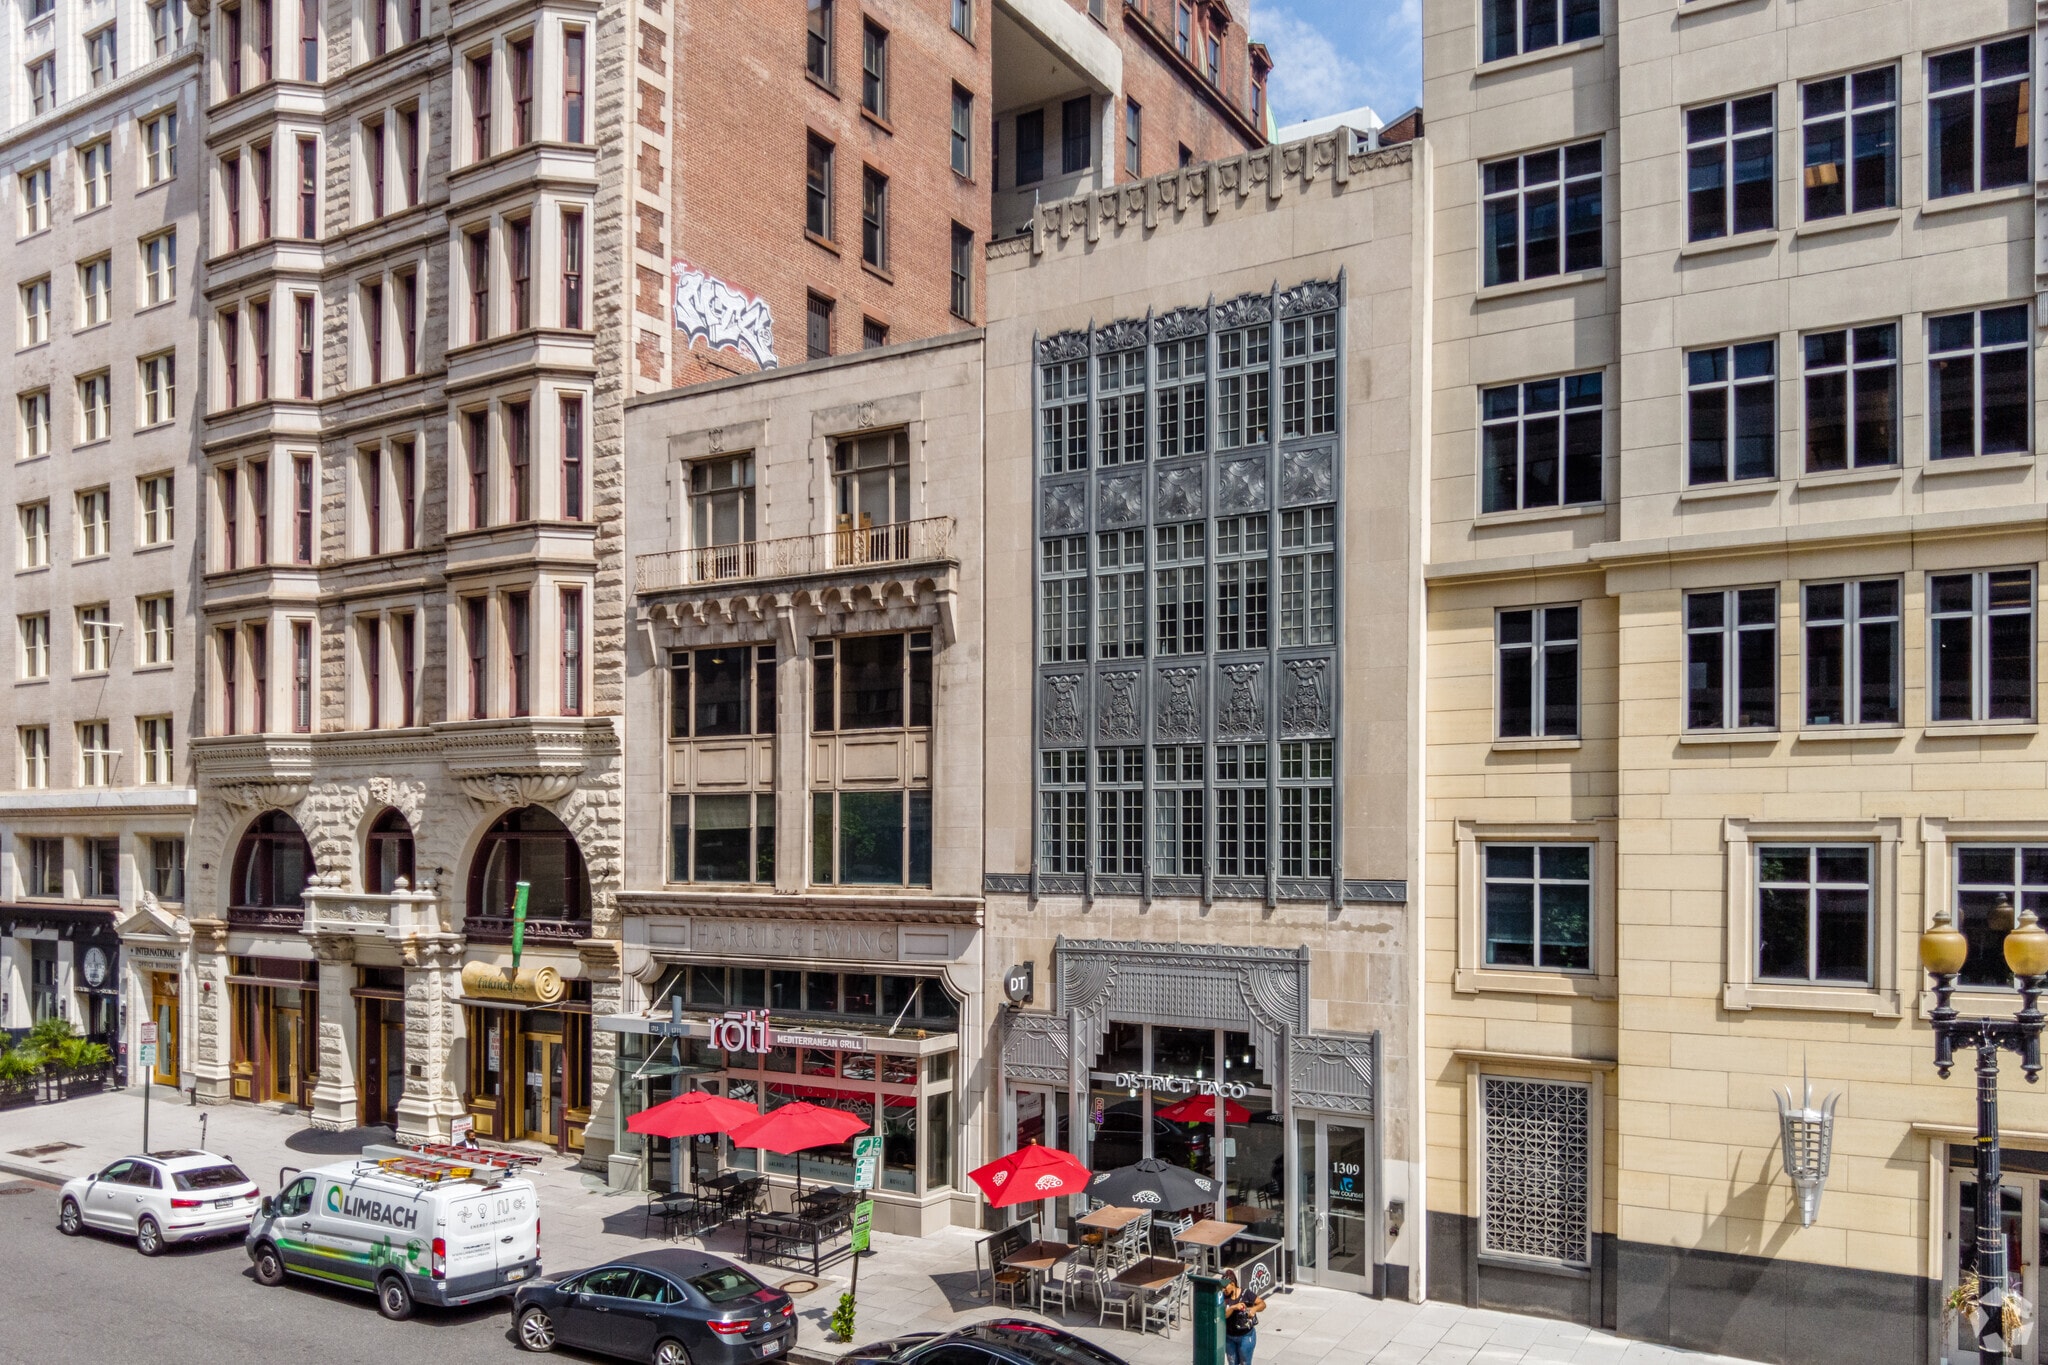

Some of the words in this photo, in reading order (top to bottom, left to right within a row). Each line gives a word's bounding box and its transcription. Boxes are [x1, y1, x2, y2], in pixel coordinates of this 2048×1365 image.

[696, 924, 782, 949] HARRIS
[790, 927, 802, 950] &
[811, 928, 893, 954] EWING
[135, 946, 176, 958] INTERNATIONAL
[1010, 976, 1026, 992] DT
[777, 1034, 838, 1048] MEDITERRANEAN
[839, 1039, 863, 1050] GRILL
[1115, 1072, 1194, 1094] DISTRICT
[1196, 1080, 1248, 1099] TACO
[1333, 1162, 1360, 1176] 1309
[343, 1195, 418, 1230] LIMBACH
